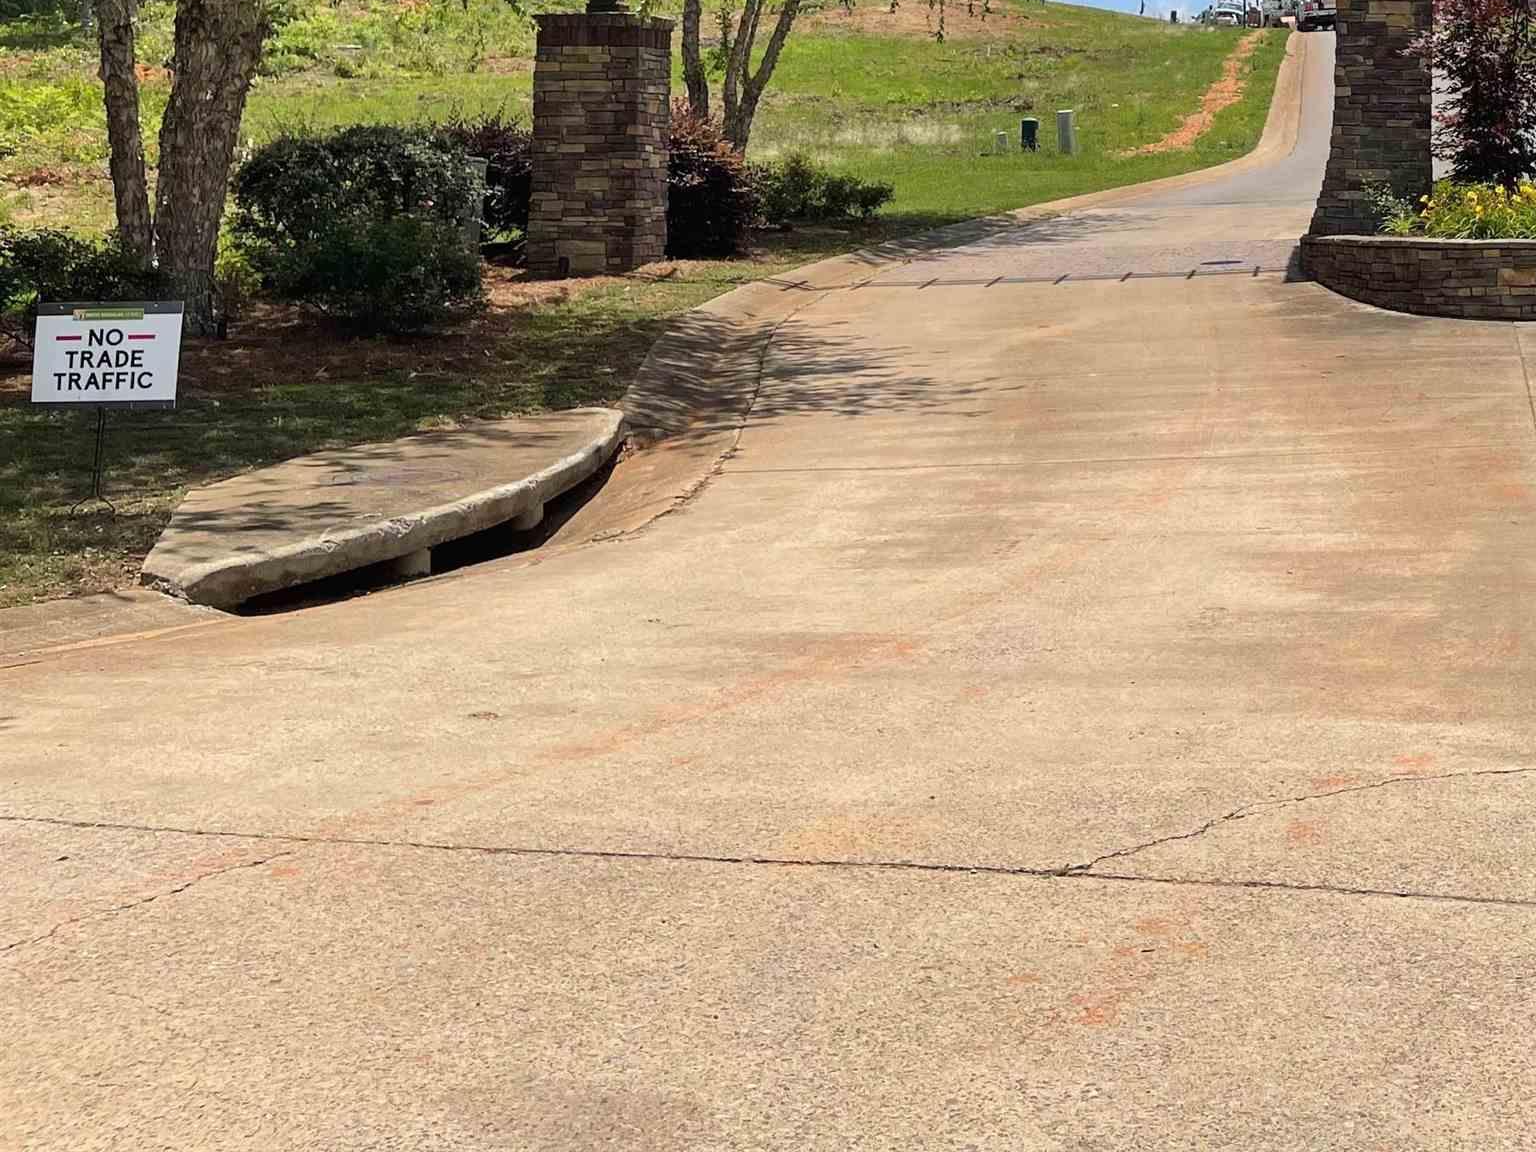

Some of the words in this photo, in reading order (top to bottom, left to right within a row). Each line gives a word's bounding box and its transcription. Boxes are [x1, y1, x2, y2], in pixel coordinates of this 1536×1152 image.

[88, 328, 124, 346] NO
[65, 350, 145, 369] TRADE
[53, 371, 154, 391] TRAFFIC
